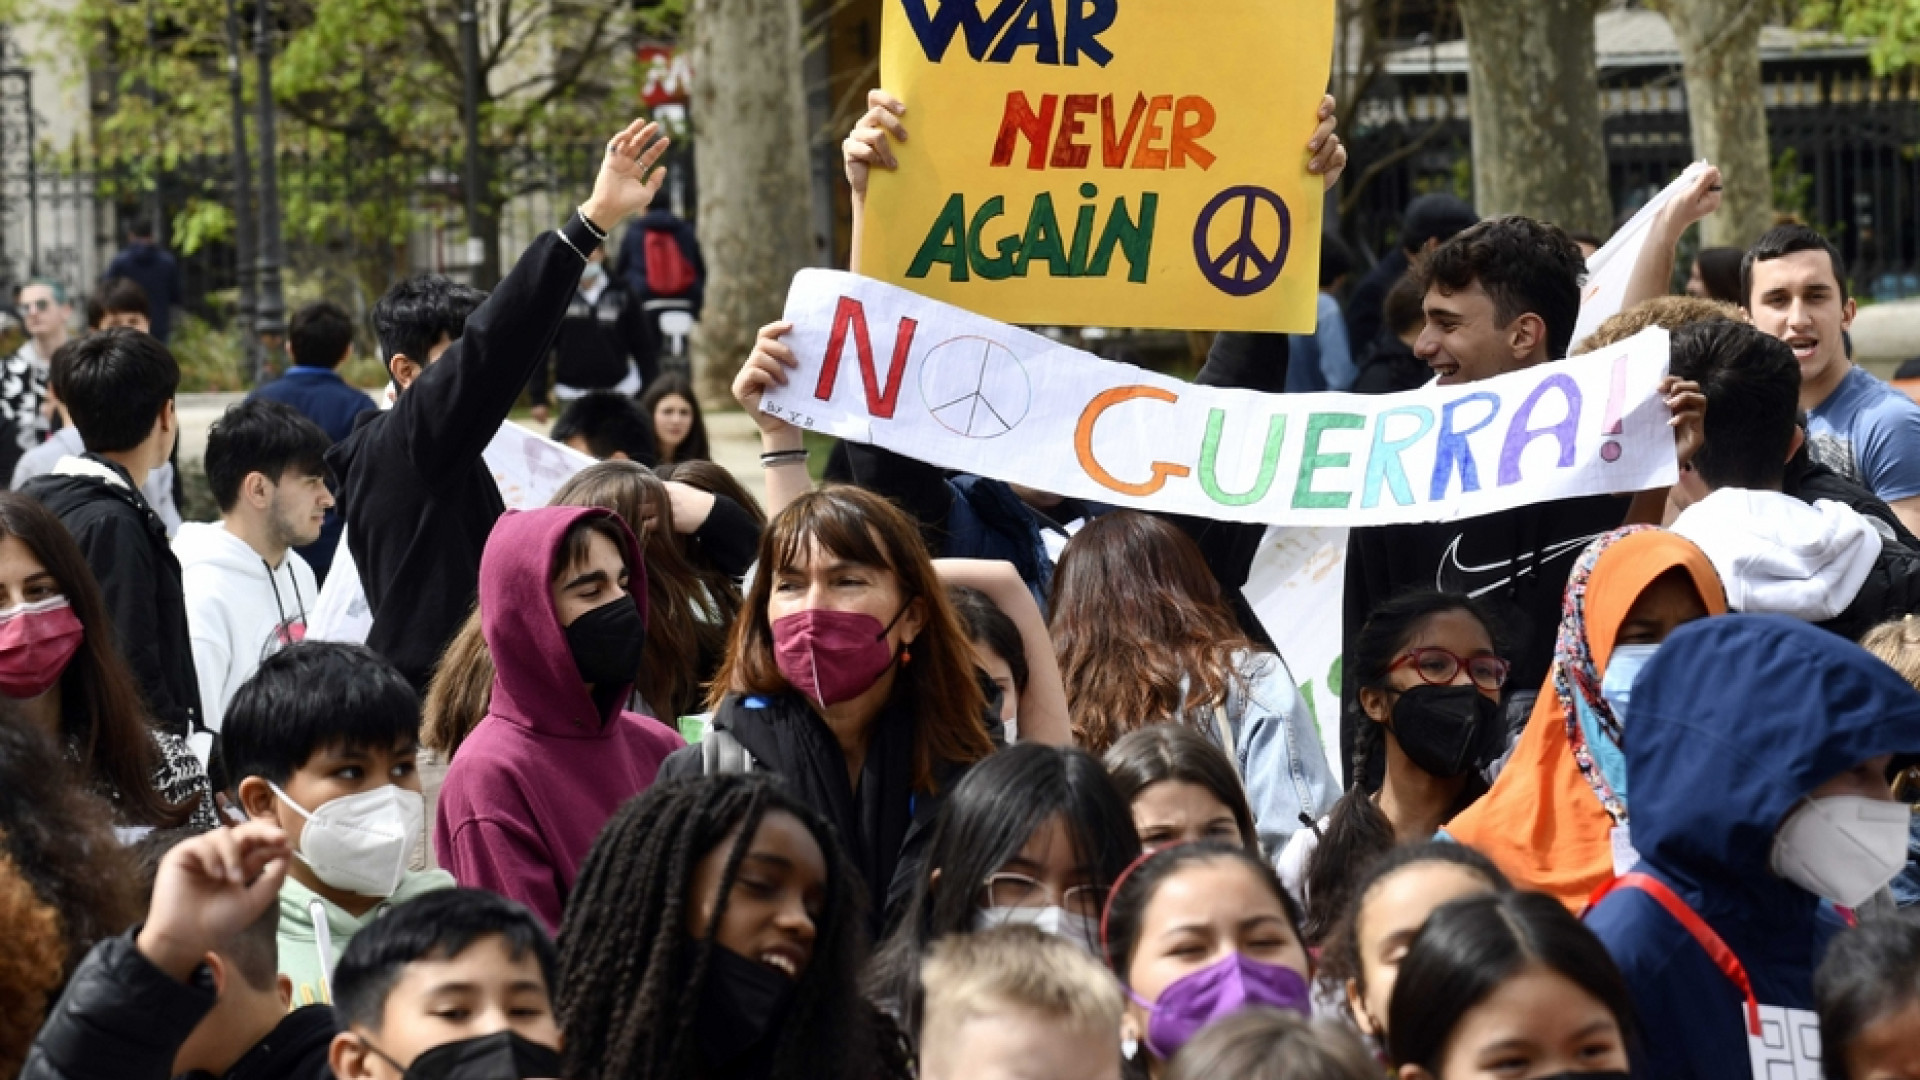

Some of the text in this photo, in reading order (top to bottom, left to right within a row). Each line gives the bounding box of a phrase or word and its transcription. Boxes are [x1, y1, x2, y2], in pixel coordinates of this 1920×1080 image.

[902, 0, 1118, 68] WAR
[990, 90, 1217, 171] NEVER
[1074, 354, 1628, 509] GUERRA!
